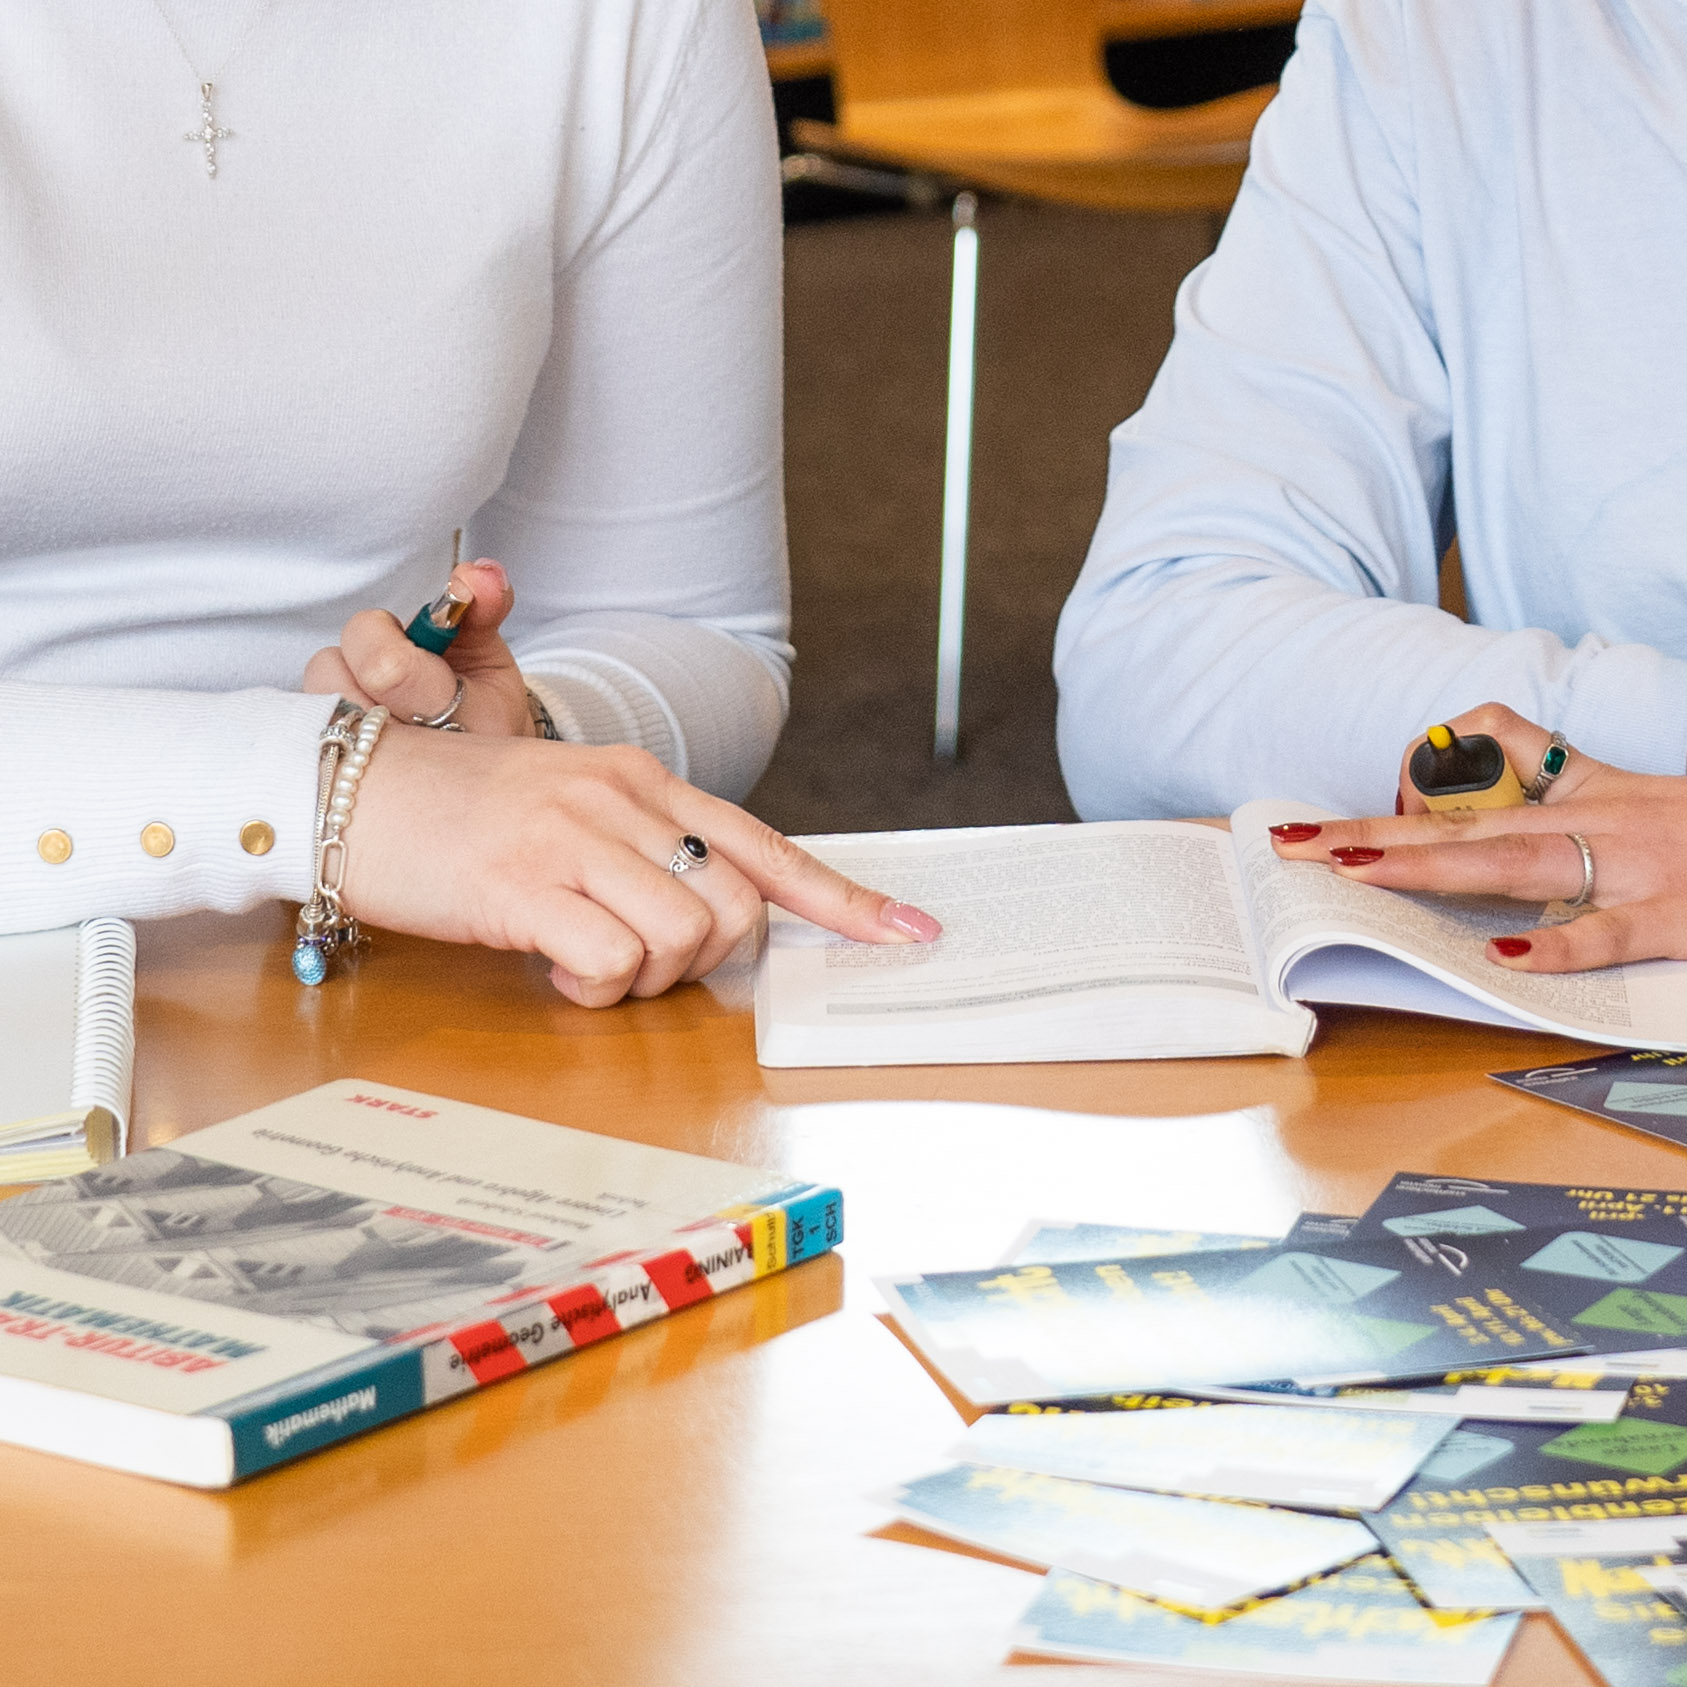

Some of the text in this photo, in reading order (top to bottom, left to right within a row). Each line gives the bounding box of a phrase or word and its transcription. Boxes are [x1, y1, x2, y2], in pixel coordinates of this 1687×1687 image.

[343, 1093, 440, 1120] STARK
[1565, 1189, 1615, 1201] Uhr
[792, 1215, 805, 1260] TGK
[808, 1224, 820, 1235] 1
[825, 1201, 838, 1243] SCH
[449, 1282, 652, 1371] Analytische Geometrie
[265, 1386, 377, 1449] Mathematik
